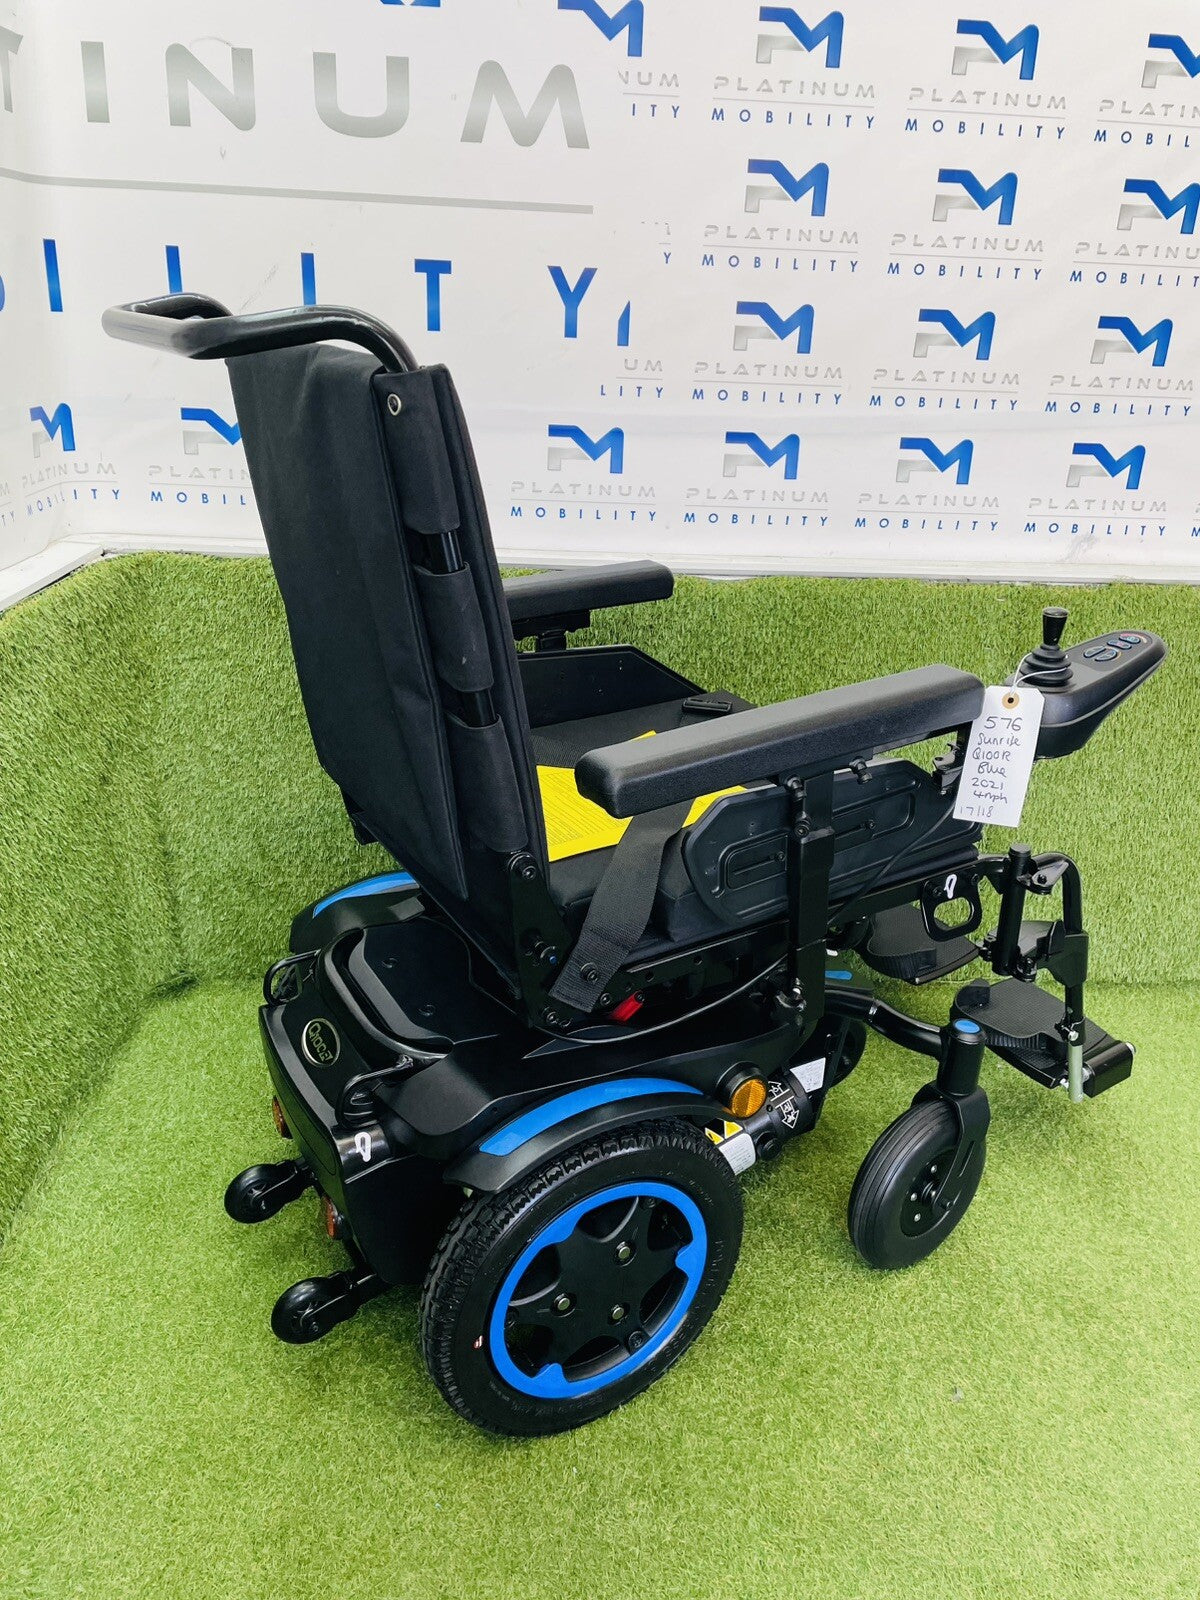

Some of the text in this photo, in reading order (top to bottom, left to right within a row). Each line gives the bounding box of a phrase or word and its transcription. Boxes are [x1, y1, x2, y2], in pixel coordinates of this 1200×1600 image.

[714, 76, 874, 98] PLATINUM
[909, 87, 1066, 109] PLATINUM
[632, 103, 680, 118] ITY
[711, 108, 875, 129] MOBILITY
[904, 118, 1065, 140] MOBILITY
[1094, 129, 1191, 149] MOBIL
[704, 225, 858, 244] PLATINUM
[891, 234, 1043, 252] PLATINUM
[1075, 242, 1200, 259] PLATINU
[702, 254, 858, 272] MOBILITY
[887, 262, 1042, 280] MOBILITY
[695, 362, 842, 379] PLATINUM
[874, 369, 1019, 385] PLATINUM
[600, 384, 664, 398] LITY
[1050, 375, 1193, 391] PLATINUM
[692, 388, 842, 405] MOBILITY
[868, 395, 1017, 410] MOBILITY
[1045, 401, 1191, 416] MOBILITY
[22, 462, 117, 489] PLATINUM
[512, 481, 655, 497] PLATINUM
[686, 488, 828, 503] PLATINUM
[27, 488, 120, 516] MOBILITY
[859, 493, 999, 507] PLATINUM
[1029, 498, 1166, 512] PLATINUM
[511, 506, 656, 521] MOBILITY
[684, 512, 828, 526] MOBILITY
[854, 518, 998, 532] MOBILITY
[1024, 522, 1166, 536] MOBILITY
[984, 716, 1023, 732] 576
[977, 762, 1007, 778] Blue
[971, 777, 1004, 790] 2021
[973, 790, 1008, 804] 4mph
